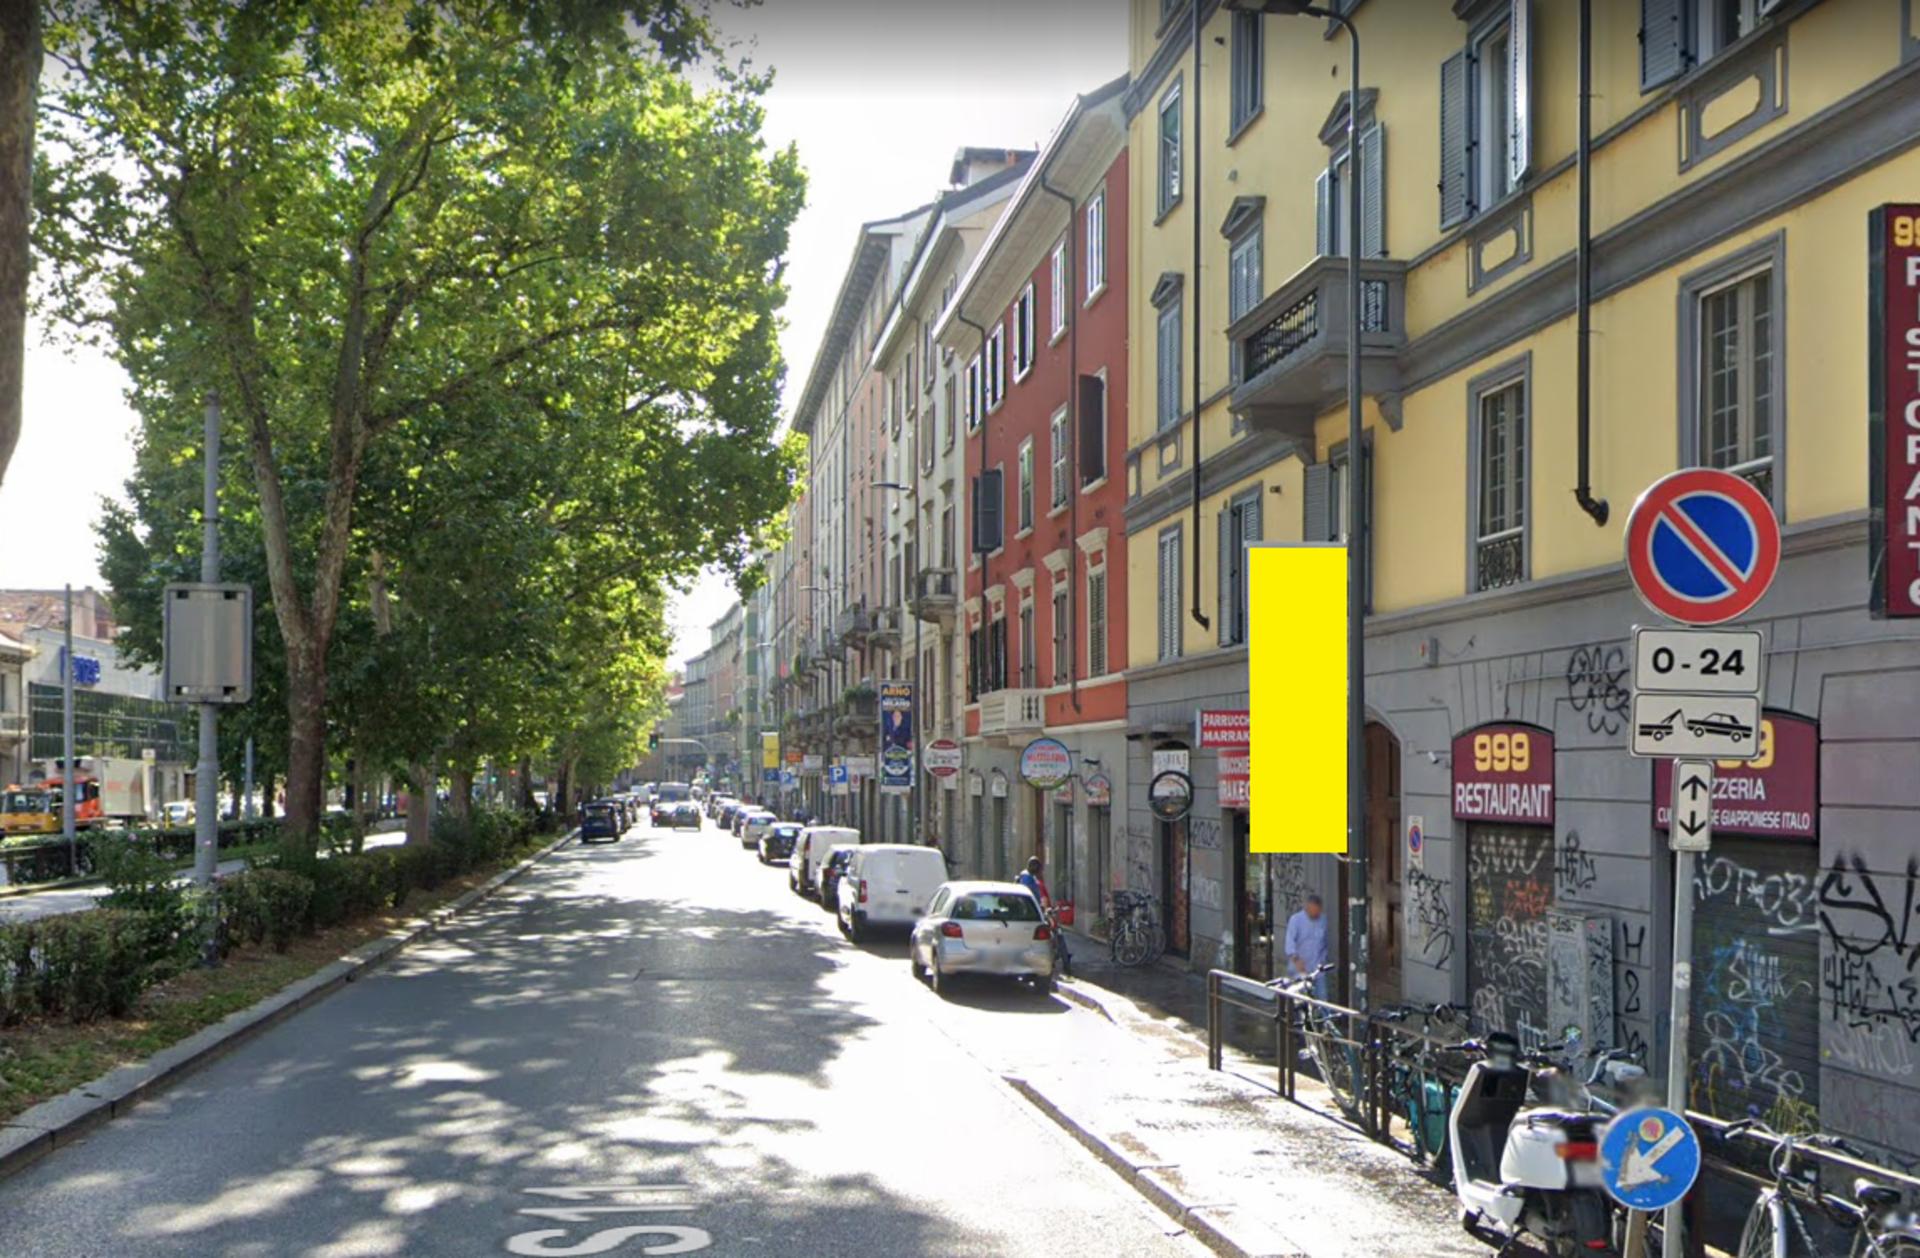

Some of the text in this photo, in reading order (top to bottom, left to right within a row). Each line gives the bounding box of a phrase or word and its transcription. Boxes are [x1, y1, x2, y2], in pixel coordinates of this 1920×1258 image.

[1652, 646, 1675, 674] 0
[1699, 648, 1745, 676] 24
[1474, 732, 1530, 772] 999
[834, 768, 844, 783] P
[1711, 777, 1767, 801] ZZERIA
[1455, 782, 1552, 818] RESTAURANT
[1720, 809, 1781, 829] GIAPPONESE
